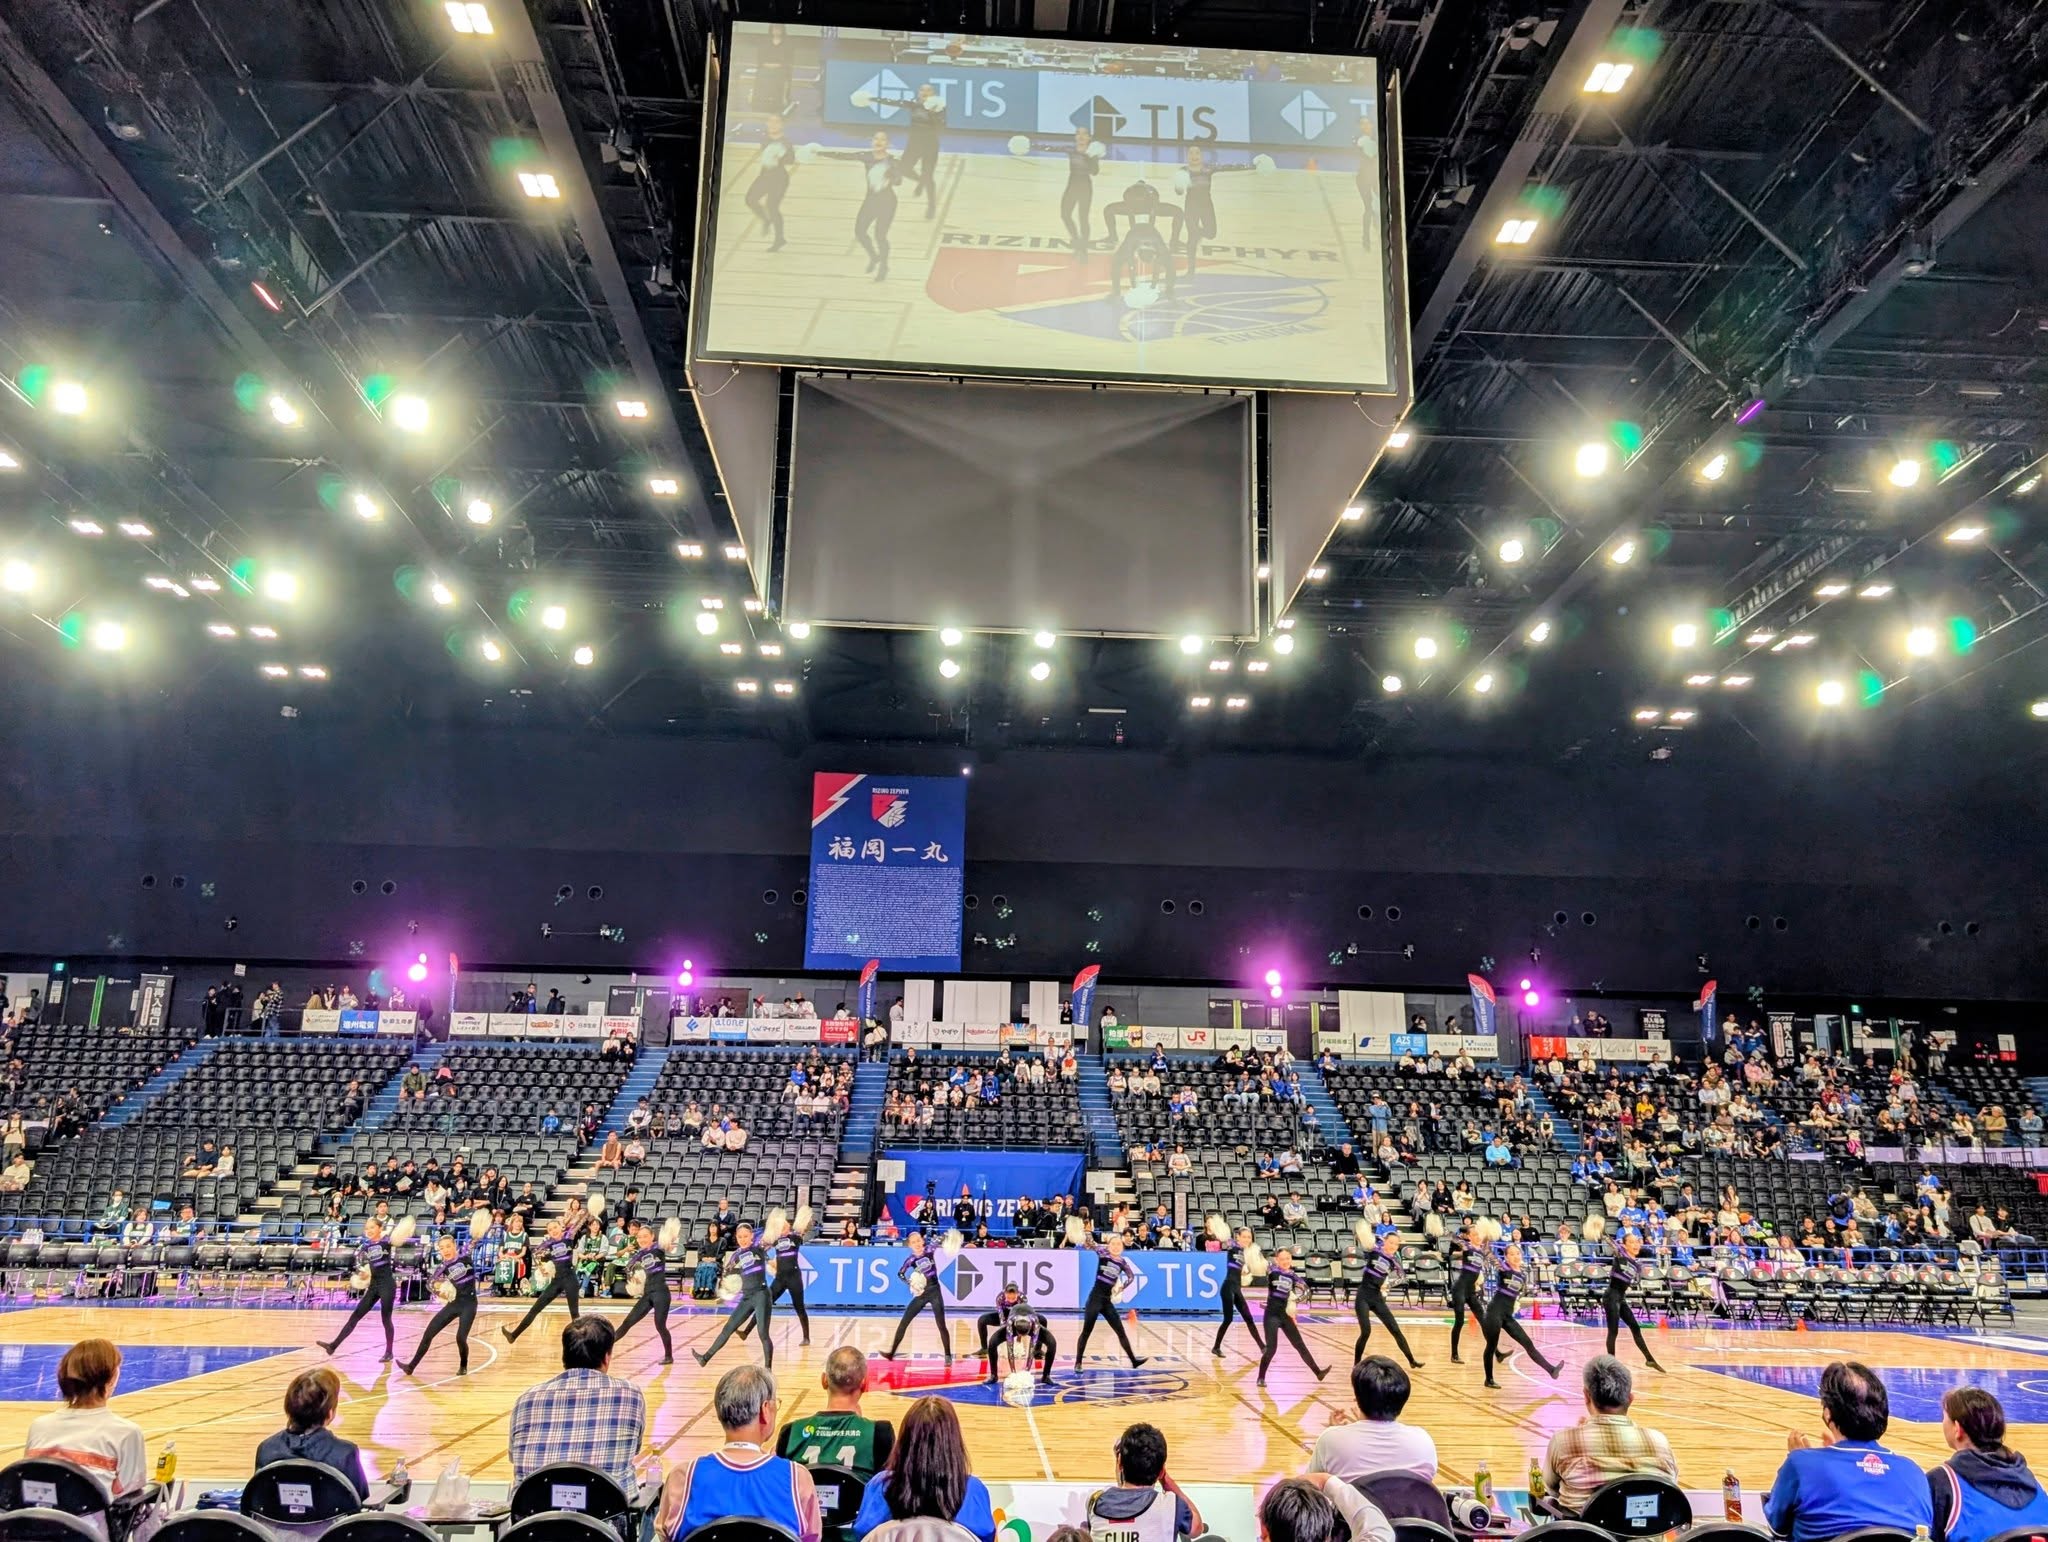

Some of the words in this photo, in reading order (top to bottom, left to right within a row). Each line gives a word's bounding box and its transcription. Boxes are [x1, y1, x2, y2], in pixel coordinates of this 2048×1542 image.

[929, 77, 1007, 119] TIS
[1139, 103, 1218, 143] TIS
[872, 787, 889, 795] RIZING
[828, 836, 949, 863] 福岡一丸
[146, 979, 166, 988] 一般
[1187, 1031, 1206, 1042] JR
[829, 1257, 891, 1294] TIS
[994, 1260, 1055, 1296] TIS
[1158, 1263, 1221, 1301] TIS
